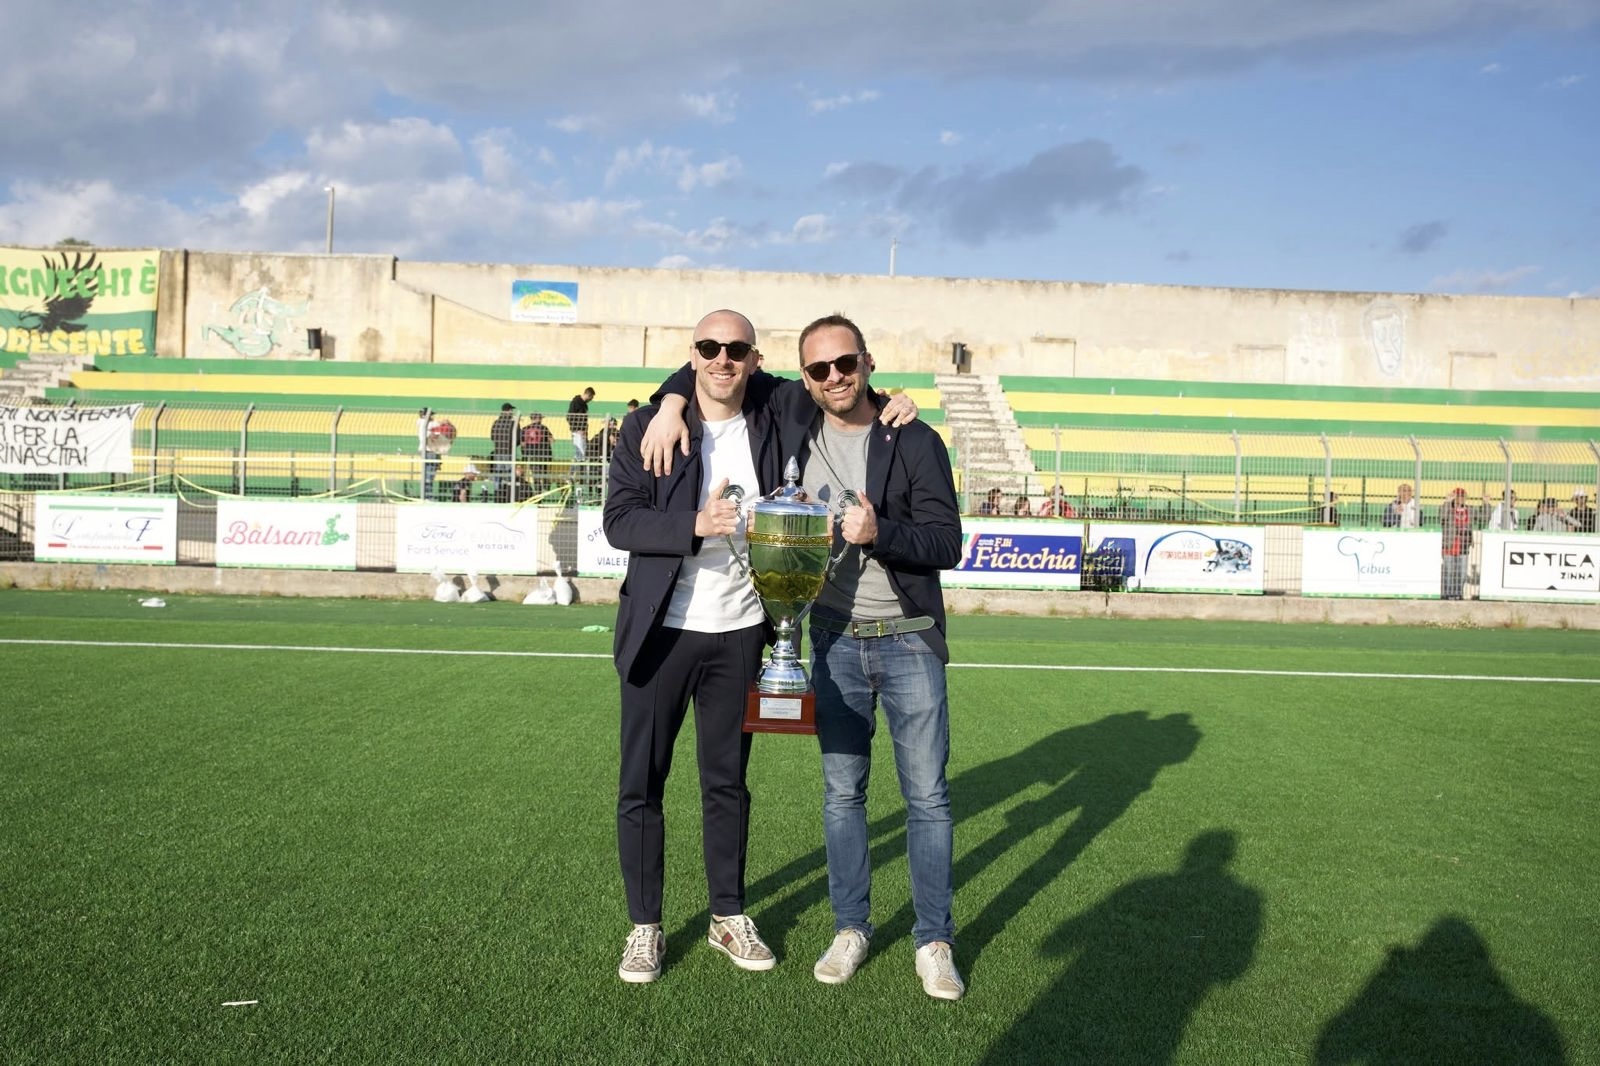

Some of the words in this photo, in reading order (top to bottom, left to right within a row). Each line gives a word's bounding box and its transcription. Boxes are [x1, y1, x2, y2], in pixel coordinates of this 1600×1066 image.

[139, 258, 157, 295] È
[13, 424, 48, 447] PER
[53, 426, 79, 447] LA
[597, 556, 621, 567] VIALE
[972, 546, 1077, 571] Ficicchia
[1509, 551, 1595, 568] OTTICA
[1359, 562, 1392, 575] cibus
[1560, 571, 1595, 581] ZINNA
